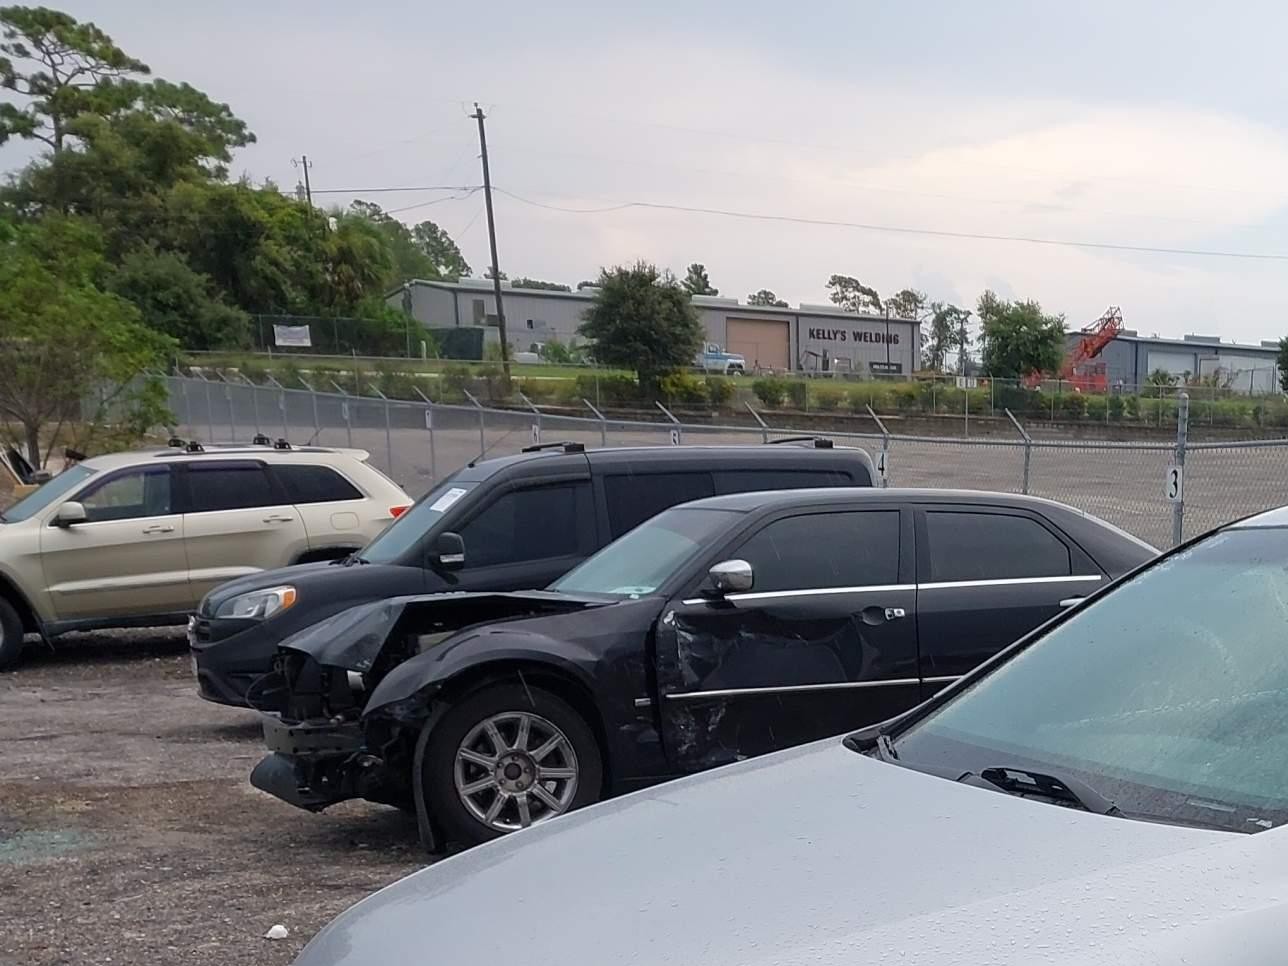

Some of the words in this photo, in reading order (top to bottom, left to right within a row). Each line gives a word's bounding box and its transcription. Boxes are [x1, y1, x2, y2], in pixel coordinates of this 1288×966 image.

[809, 328, 846, 341] KELLY'S
[852, 331, 899, 345] WELDING
[878, 454, 884, 476] 4
[1169, 469, 1178, 498] 3
